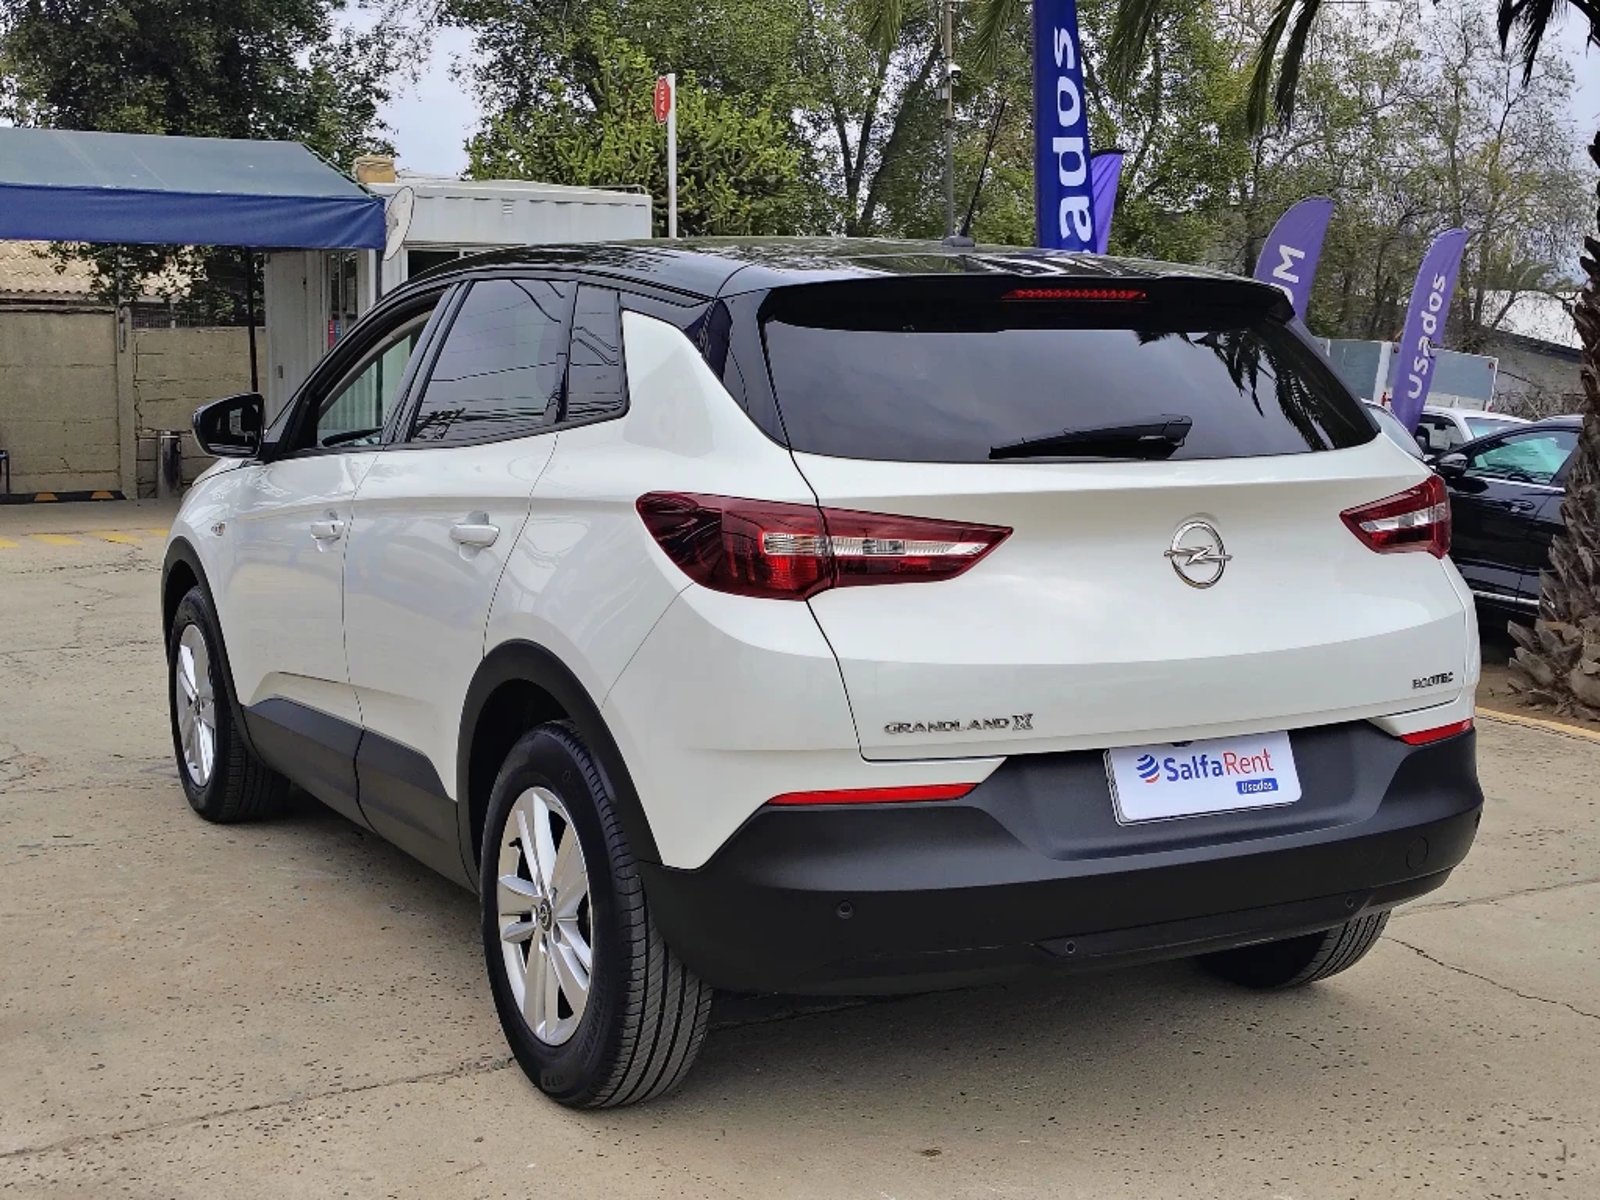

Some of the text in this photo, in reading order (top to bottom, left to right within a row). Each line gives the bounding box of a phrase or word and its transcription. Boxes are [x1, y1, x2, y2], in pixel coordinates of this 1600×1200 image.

[1053, 26, 1092, 254] ados
[884, 712, 1034, 735] GRANDLAND X
[1162, 748, 1274, 783] SalfaRent
[1240, 779, 1274, 793] Usados
